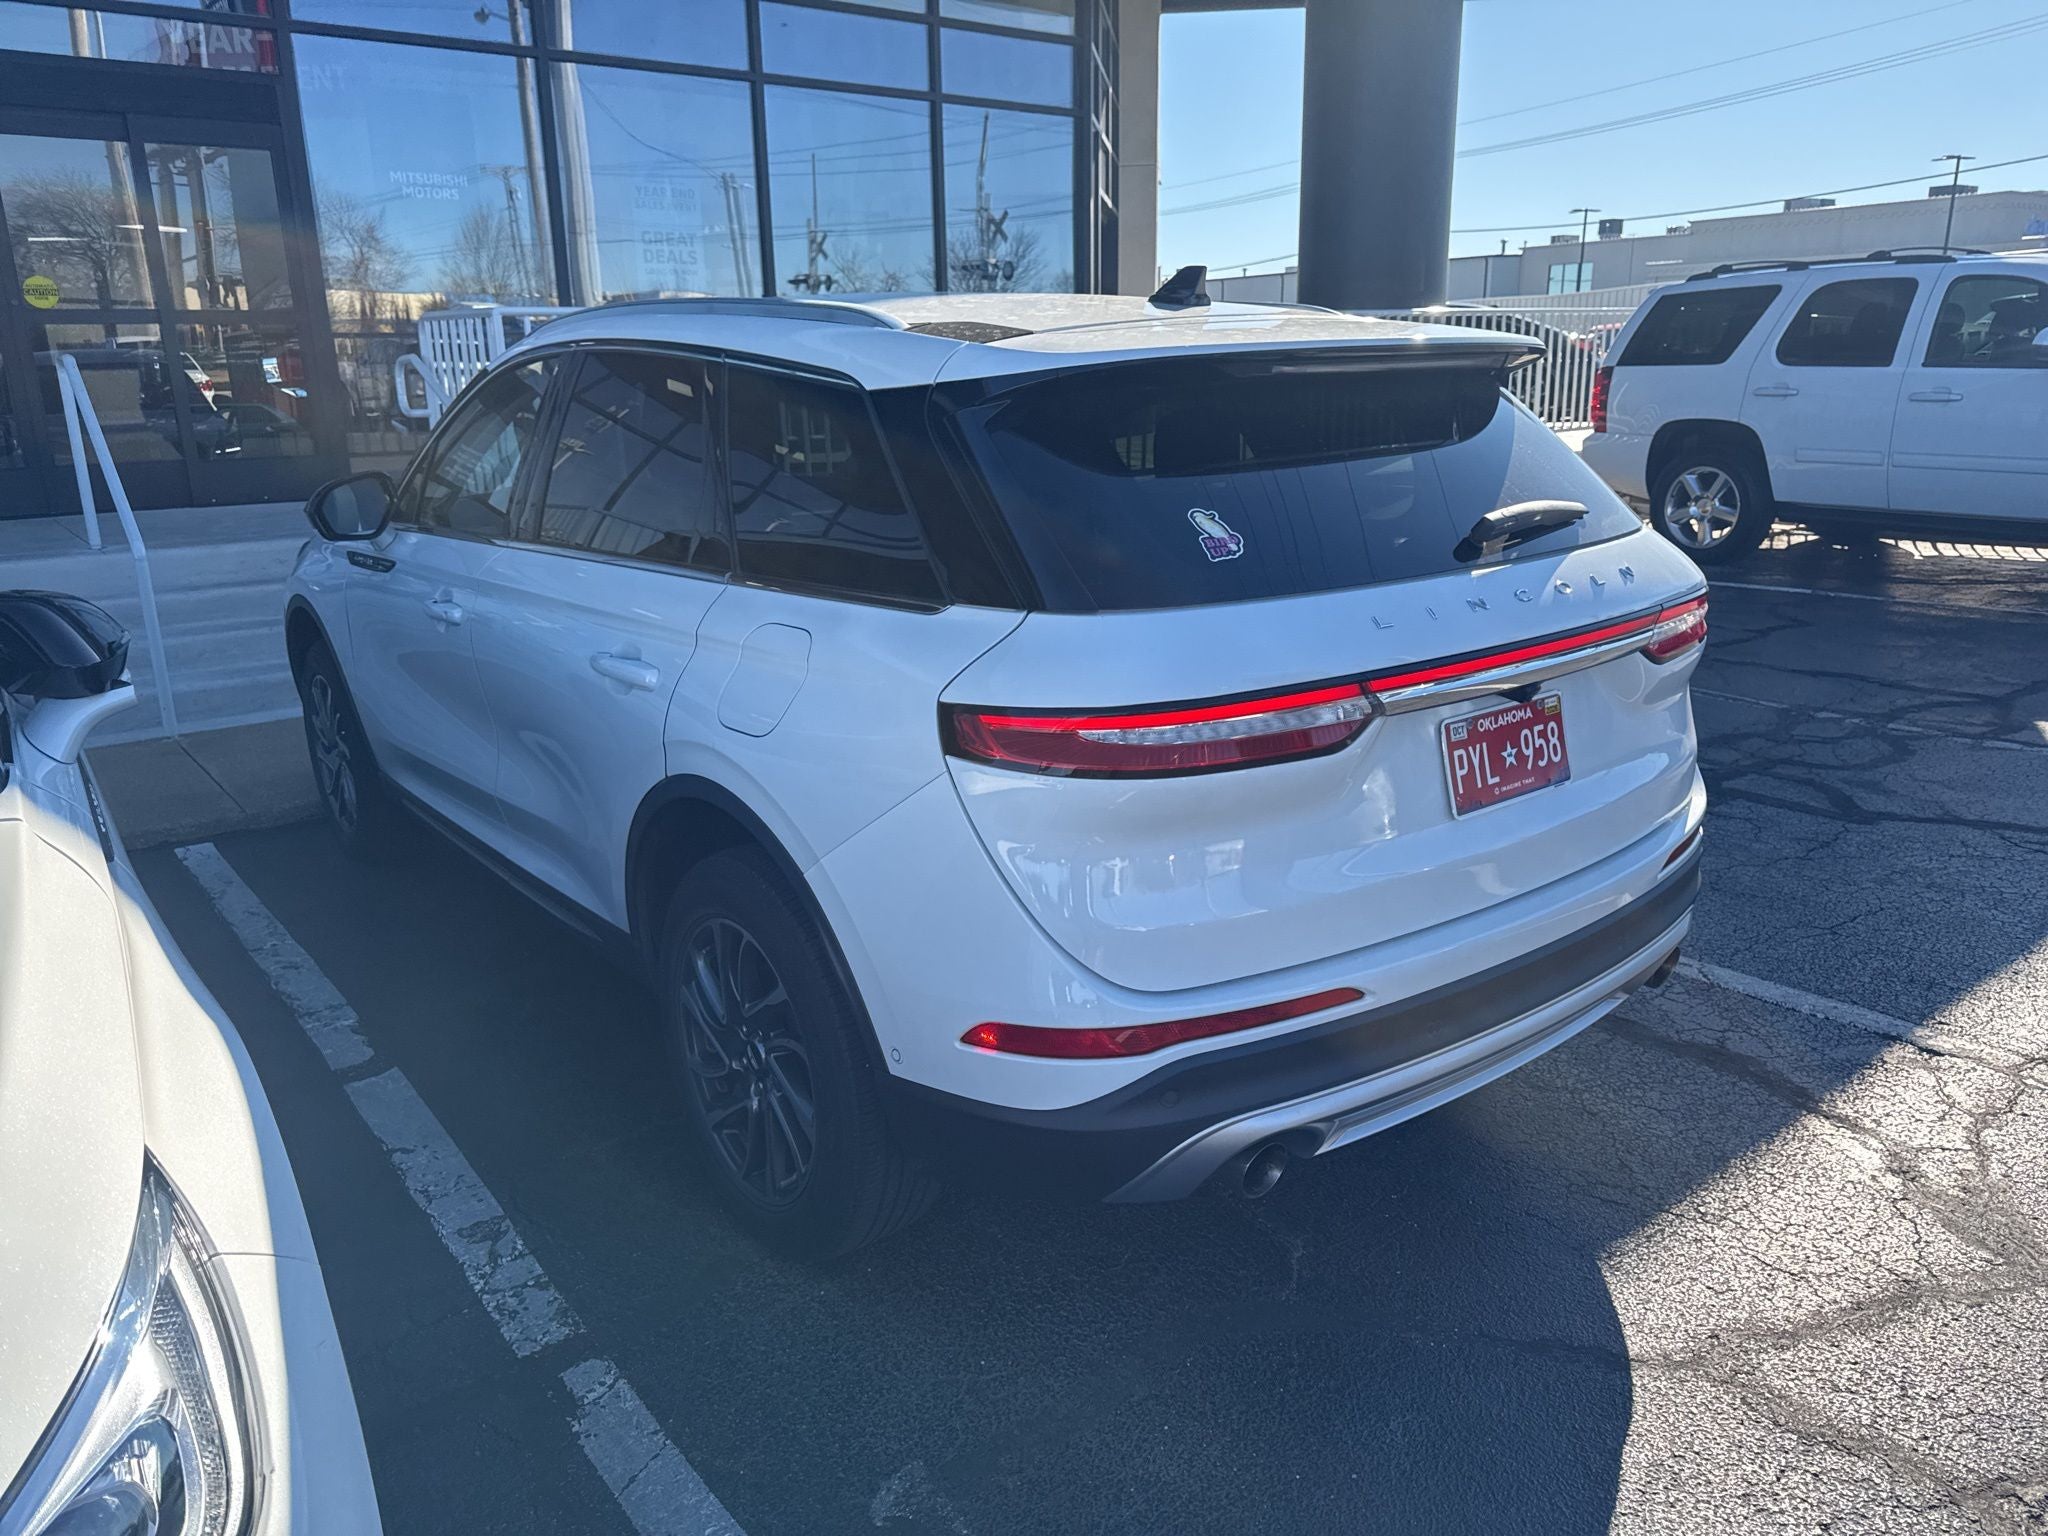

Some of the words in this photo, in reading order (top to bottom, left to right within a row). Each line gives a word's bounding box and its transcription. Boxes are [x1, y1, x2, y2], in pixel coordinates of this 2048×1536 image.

[389, 171, 468, 187] MITSUBISHI
[402, 186, 460, 200] MOTORS
[641, 230, 697, 248] GREAT
[642, 248, 699, 266] DEALS
[23, 288, 59, 296] CAUTION
[1371, 565, 1635, 630] LINCOLN
[1478, 707, 1533, 731] OKLAHOMA
[1452, 725, 1466, 737] OCT
[1453, 742, 1500, 794] PYL
[1520, 721, 1562, 770] 958
